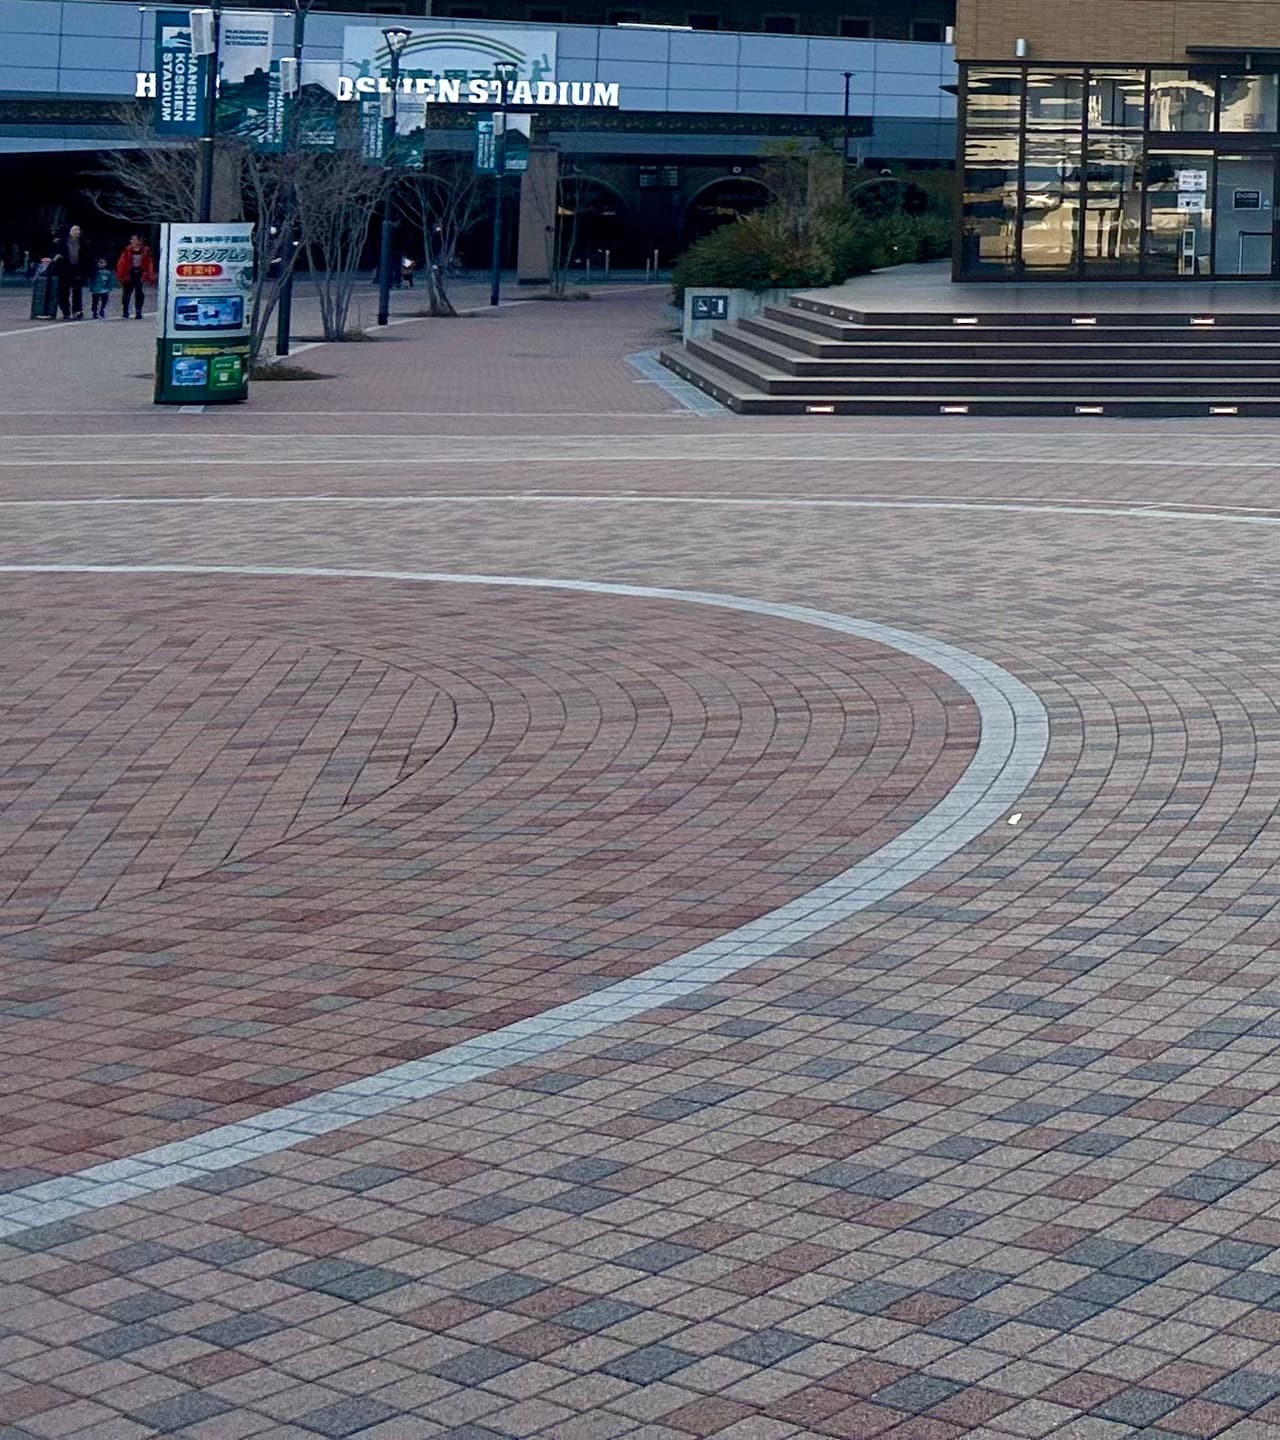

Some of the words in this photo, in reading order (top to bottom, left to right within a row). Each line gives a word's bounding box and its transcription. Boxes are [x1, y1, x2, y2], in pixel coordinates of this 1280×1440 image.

[160, 52, 173, 122] STADIUM
[173, 52, 186, 122] KOSHIEN
[185, 52, 199, 122] HANSHIN
[469, 78, 620, 107] STADIUM
